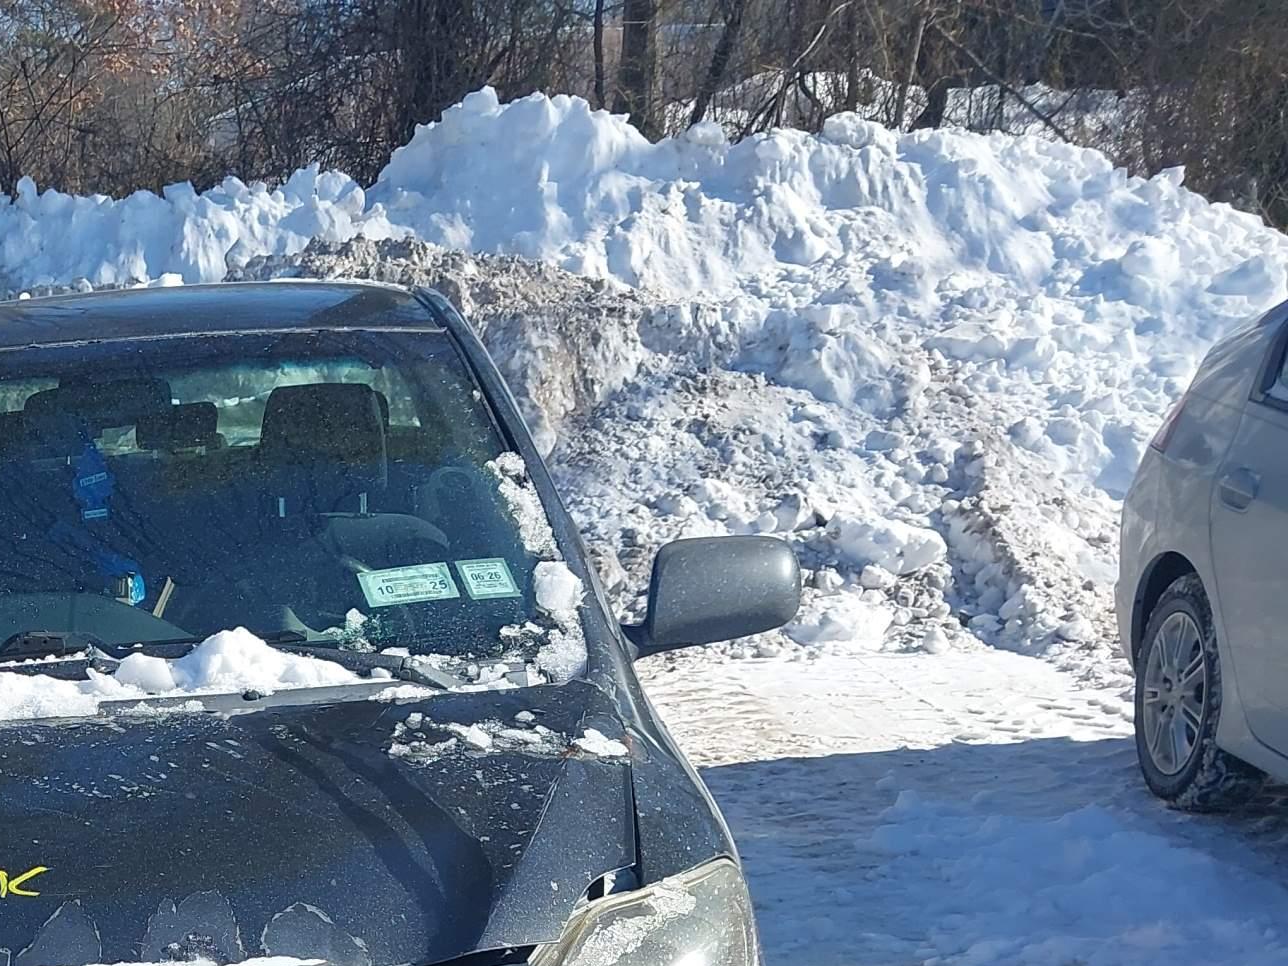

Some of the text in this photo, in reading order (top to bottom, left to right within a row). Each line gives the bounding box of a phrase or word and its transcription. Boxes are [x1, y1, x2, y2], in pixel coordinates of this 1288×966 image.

[470, 572, 485, 581] 06
[377, 579, 448, 596] 10 25
